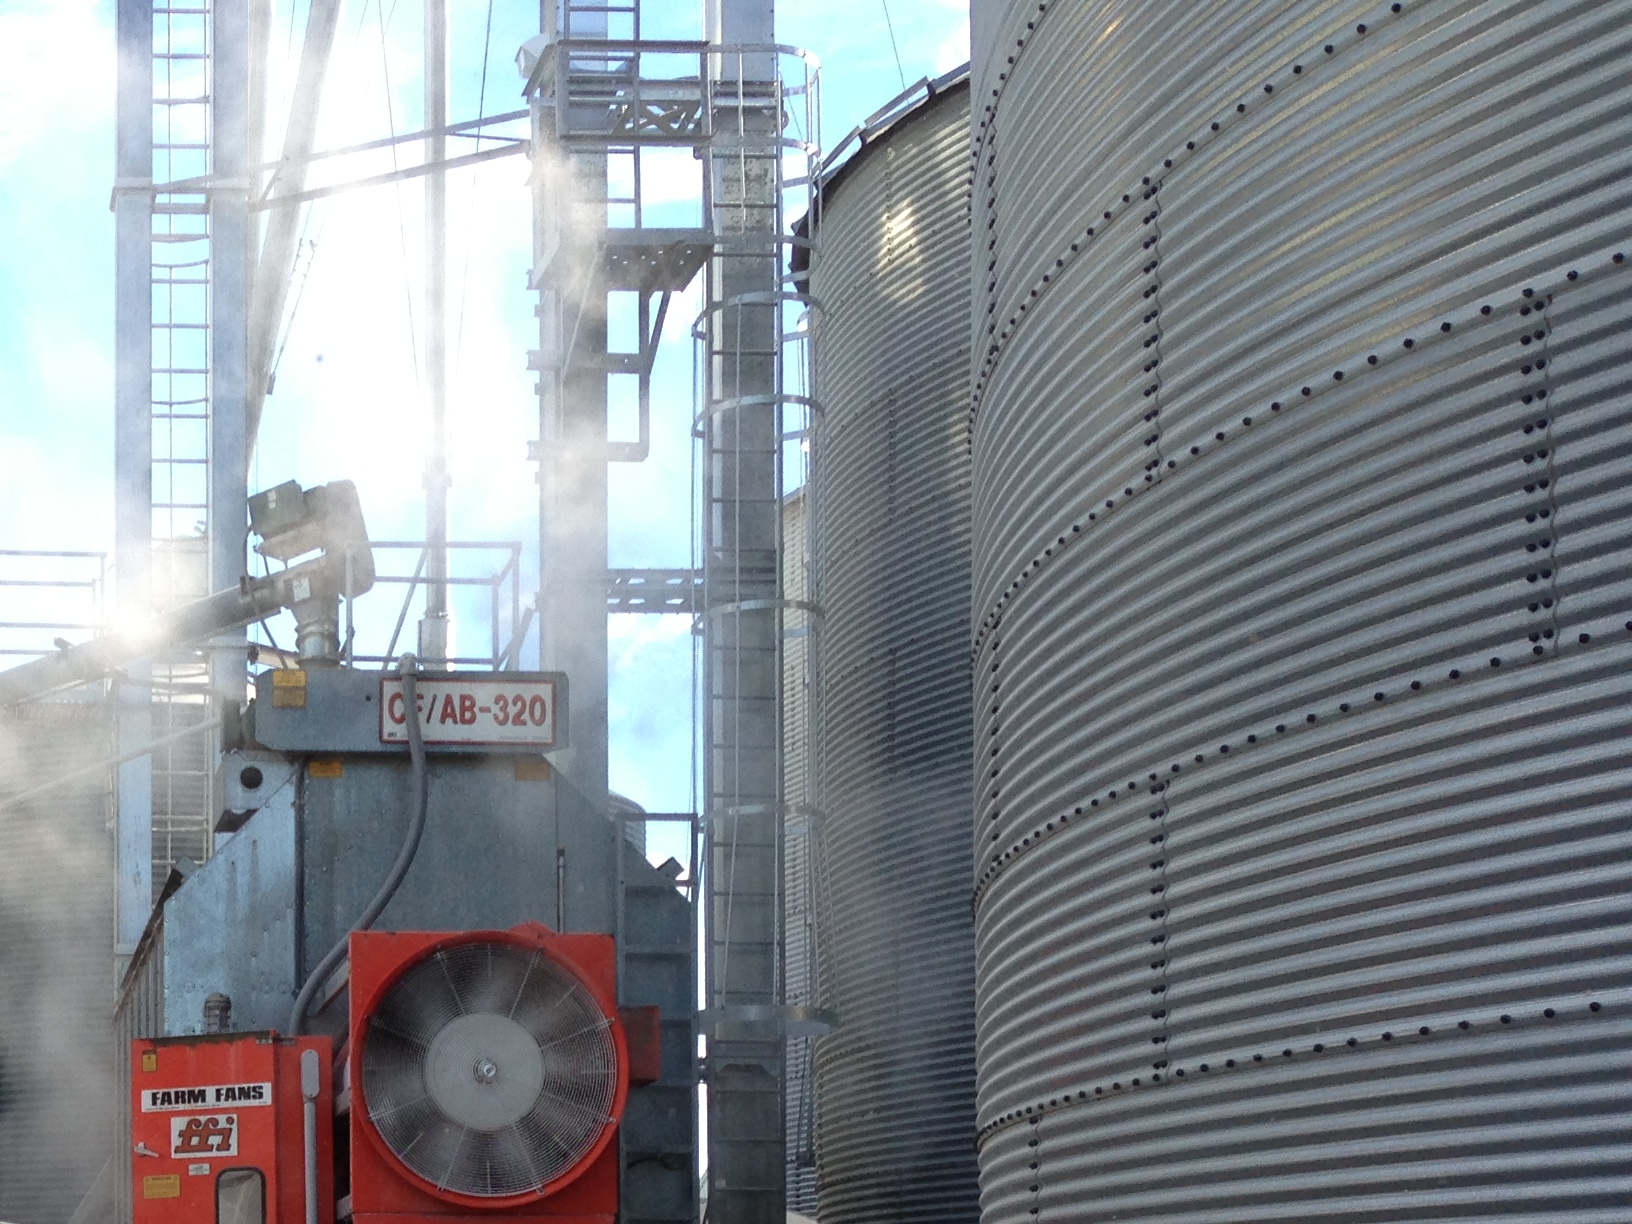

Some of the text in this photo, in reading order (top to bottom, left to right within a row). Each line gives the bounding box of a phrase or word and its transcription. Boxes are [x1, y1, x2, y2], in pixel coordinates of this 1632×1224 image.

[151, 1084, 264, 1107] FARM FANS
[173, 1115, 235, 1154] ffi
